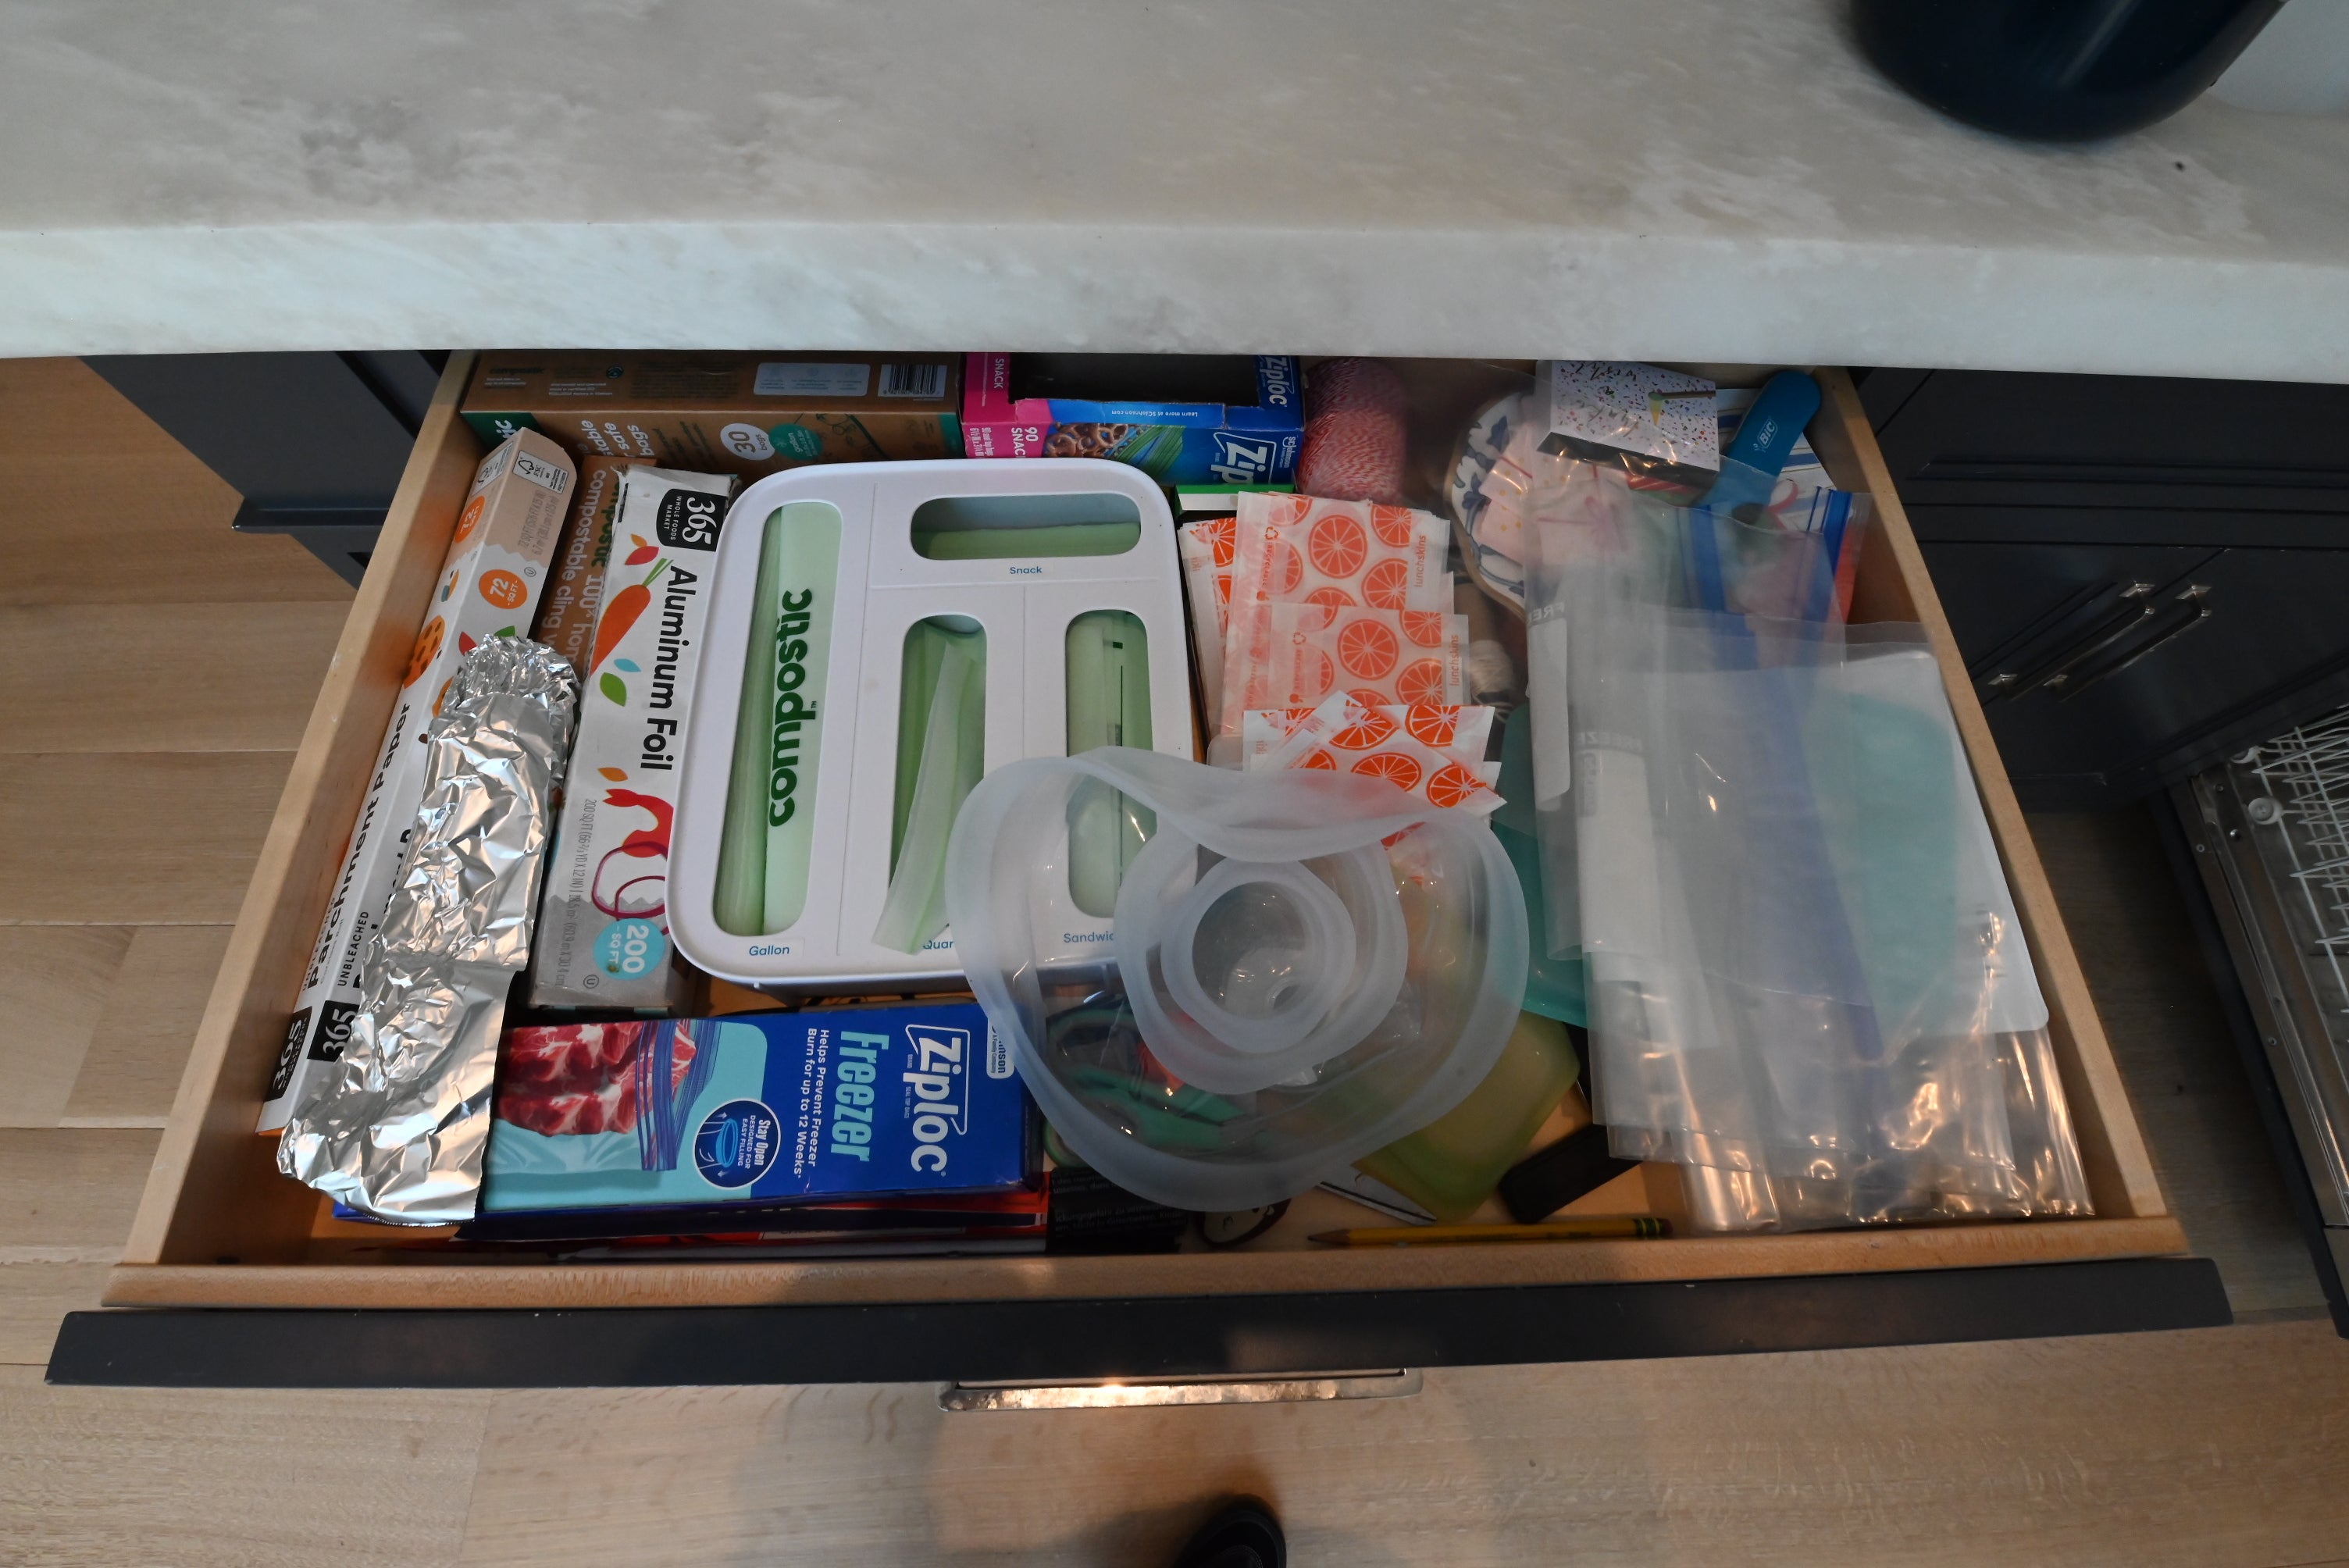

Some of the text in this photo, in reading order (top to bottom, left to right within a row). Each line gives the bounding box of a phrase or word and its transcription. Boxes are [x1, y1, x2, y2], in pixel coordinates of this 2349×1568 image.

[994, 358, 1005, 389] SNACK
[1260, 356, 1289, 406] Ziploc
[604, 422, 630, 450] safe
[627, 425, 655, 455] bags
[728, 431, 756, 453] 30
[756, 433, 768, 451] bags
[1011, 427, 1026, 458] SNAC
[1025, 426, 1039, 442] 90
[1759, 422, 1775, 445] BIC
[1211, 442, 1267, 484] Zip
[664, 504, 673, 529] MARKET
[670, 496, 683, 541] WHOLE FOODS
[682, 497, 717, 545] 365
[541, 470, 608, 629] compostable cling
[1414, 534, 1428, 588] lunchskins
[1010, 565, 1043, 575] Snack
[490, 578, 509, 597] 72
[508, 583, 519, 603] SQ FT
[565, 620, 597, 665] hom
[640, 565, 698, 770] Aluminum Foil
[1449, 634, 1460, 687] lunchskins
[769, 588, 817, 828] compostic
[582, 813, 594, 821] SQ
[583, 799, 597, 812] 200
[308, 796, 379, 989] Parchment
[373, 704, 411, 792] Paper
[578, 832, 591, 843] (66
[575, 853, 587, 862] YD
[571, 878, 583, 888] IN)
[561, 922, 575, 941] (60.9
[922, 939, 954, 950] Quar
[1064, 930, 1114, 943] Sandwic
[337, 911, 369, 986] UNBLEACHED
[609, 933, 621, 964] SQ FT
[622, 925, 649, 973] 200
[749, 944, 790, 957] Gallon
[555, 957, 569, 971] 30.4
[323, 1008, 358, 1054] 365
[806, 1028, 818, 1056] Burn
[273, 1018, 302, 1091] 365
[804, 1059, 815, 1077] for
[800, 1080, 811, 1095] up
[808, 1029, 829, 1167] Helps Prevent Freezer
[831, 1031, 889, 1162] Freezer
[800, 1099, 811, 1111] to
[903, 1037, 962, 1172] Ziploc
[746, 1114, 756, 1154] DESIGNED
[798, 1115, 809, 1128] 12
[737, 1136, 747, 1166] FILLING
[754, 1119, 771, 1166] Stay Open
